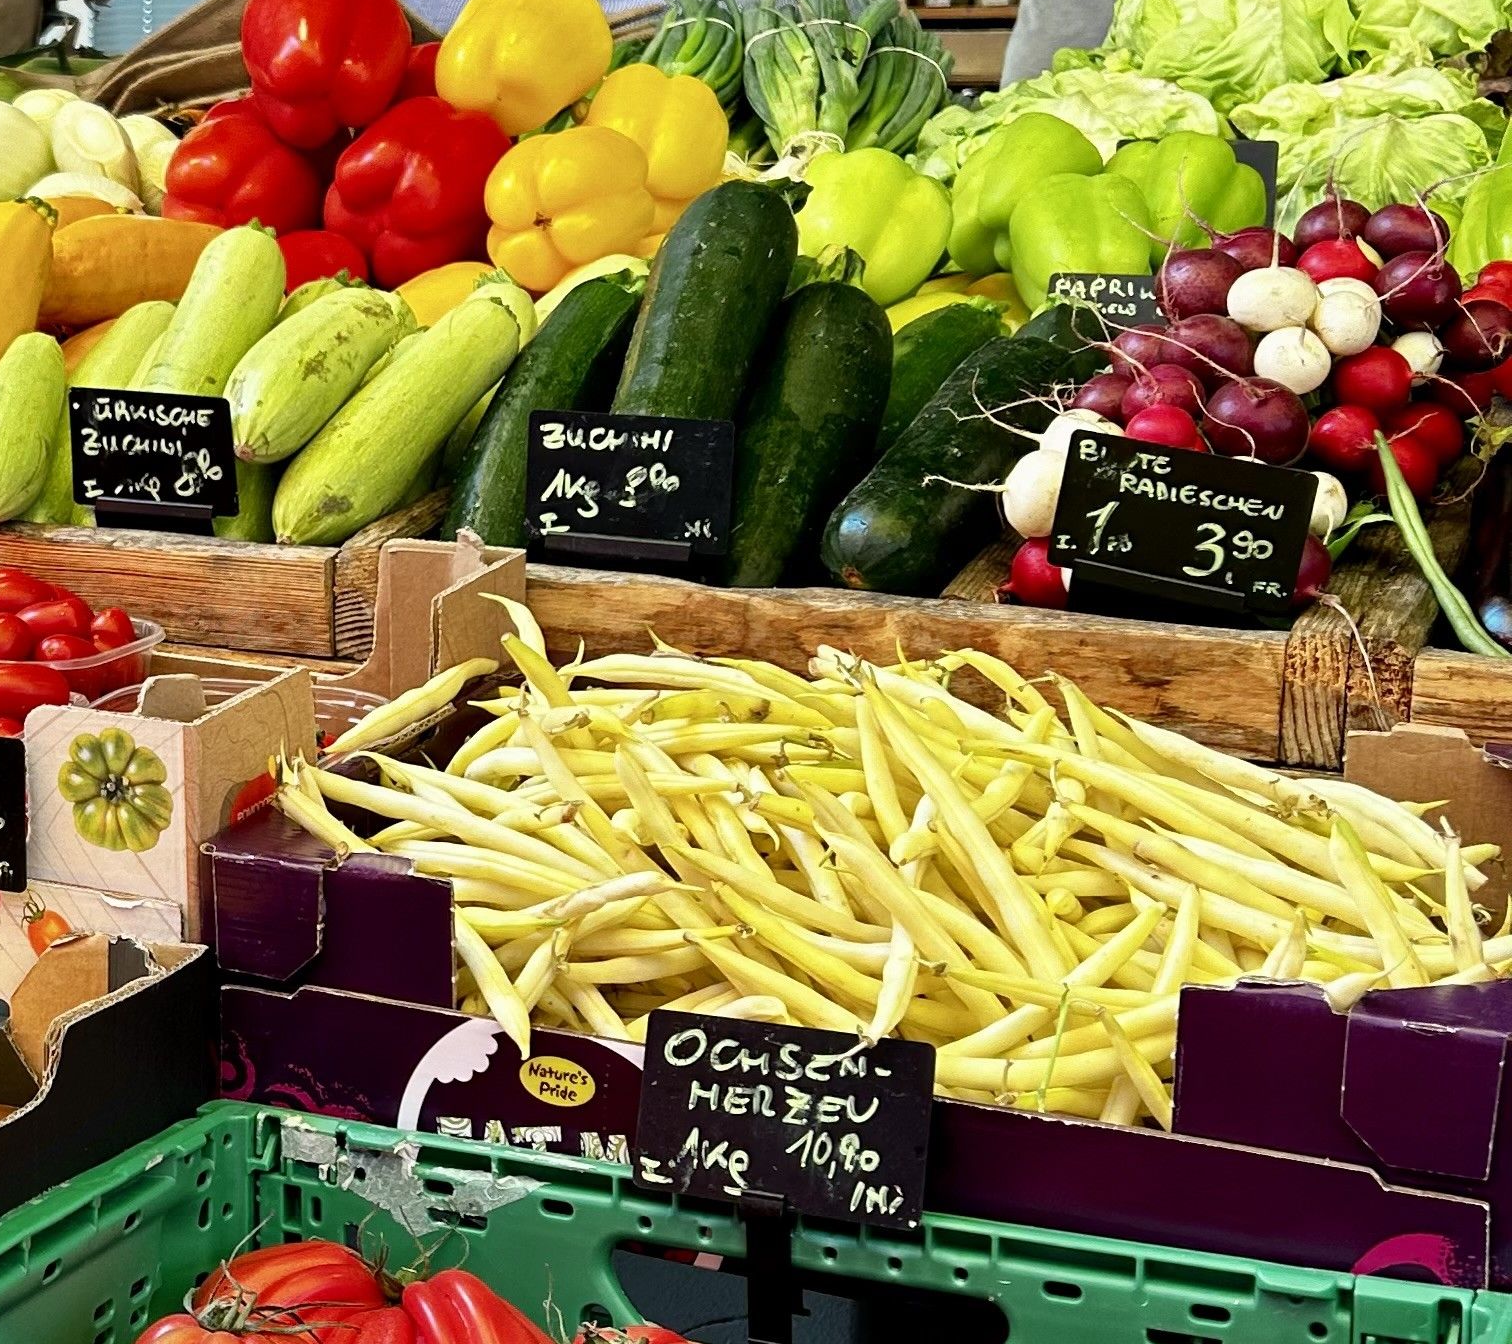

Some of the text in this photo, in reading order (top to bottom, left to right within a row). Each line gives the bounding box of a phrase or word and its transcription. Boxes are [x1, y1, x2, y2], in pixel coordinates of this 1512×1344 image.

[1118, 473, 1285, 520] RADIESCHEN
[664, 1028, 892, 1082] OCHSEN-
[528, 1062, 588, 1086] Nature's
[539, 1081, 578, 1103] Pride
